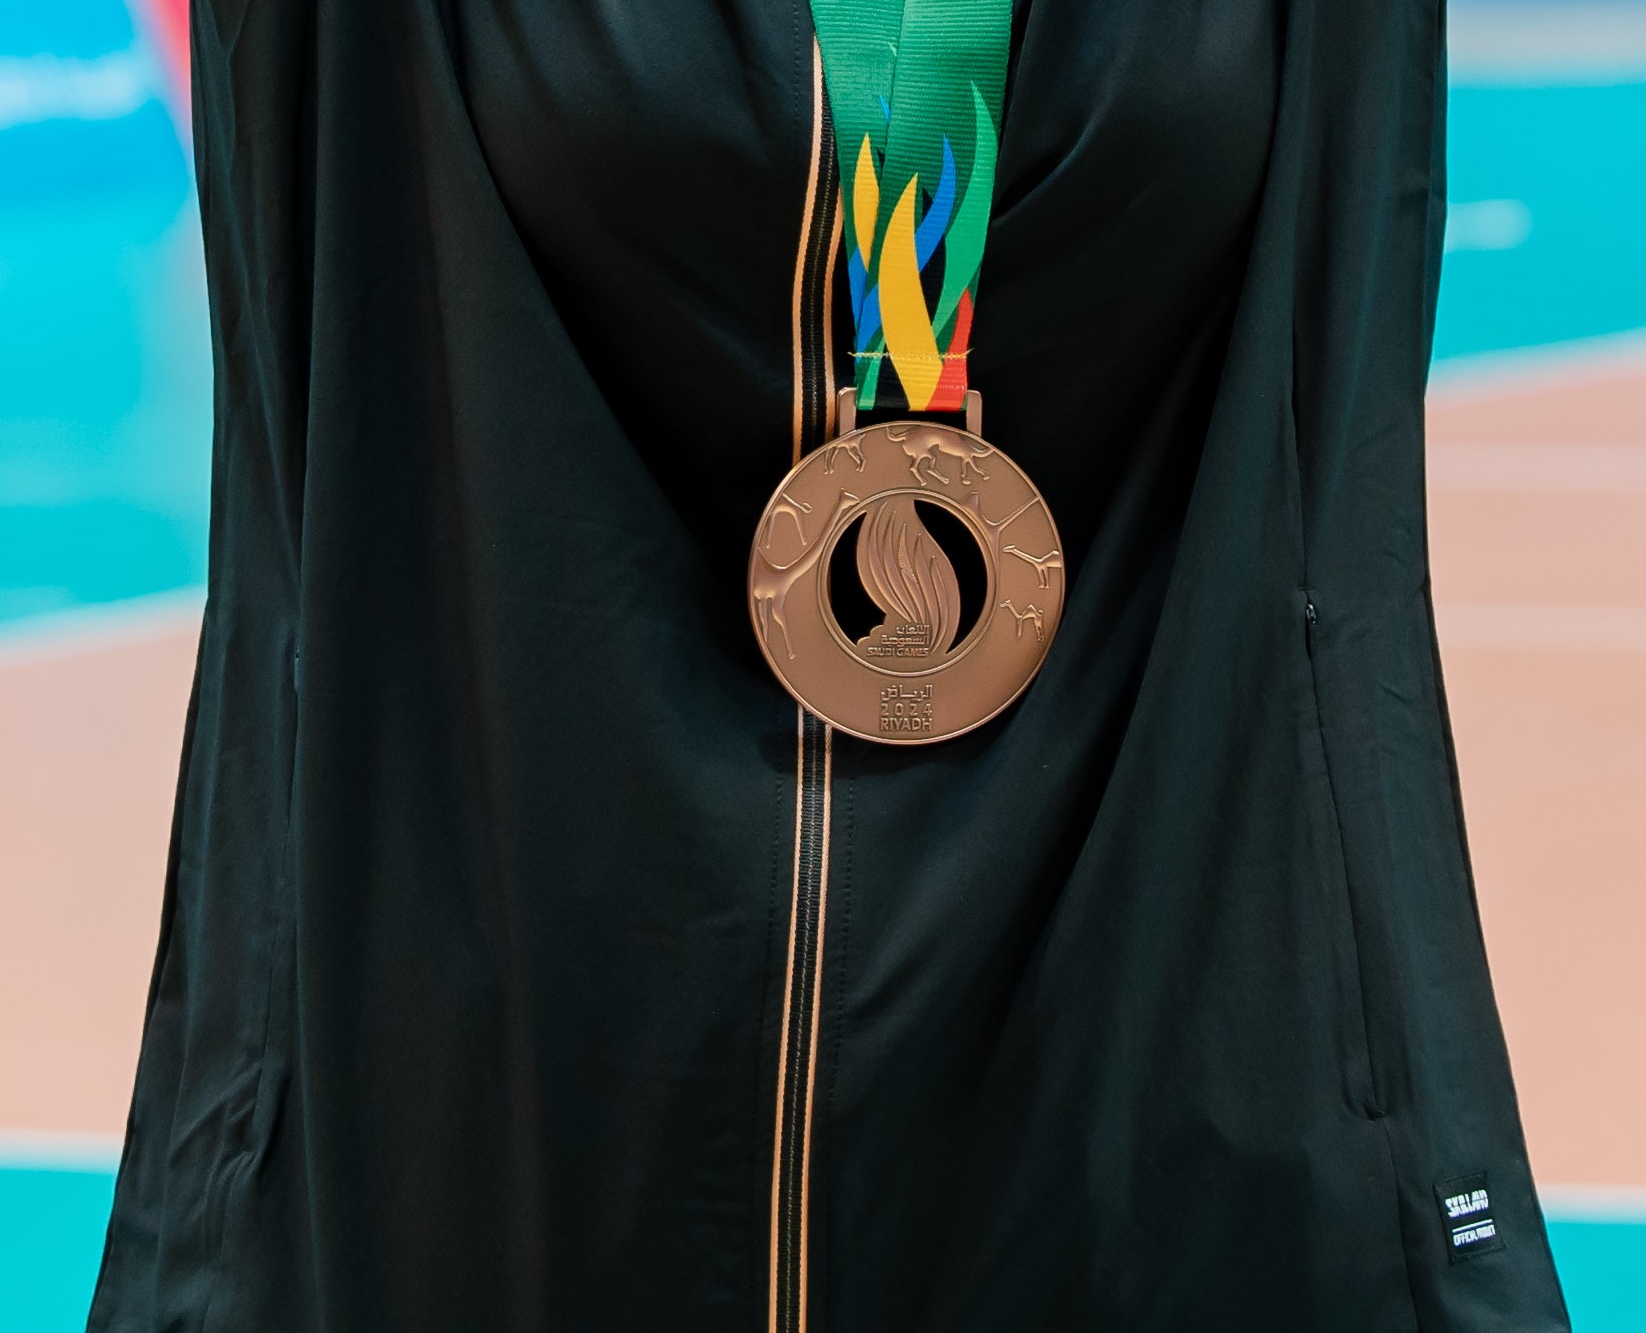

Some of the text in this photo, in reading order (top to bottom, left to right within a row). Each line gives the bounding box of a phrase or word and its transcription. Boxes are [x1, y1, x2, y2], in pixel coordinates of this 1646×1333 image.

[866, 646, 930, 657] SAUDI GAMES
[880, 684, 933, 702] الرياض
[880, 702, 933, 717] 2024
[880, 717, 933, 731] RIYADH
